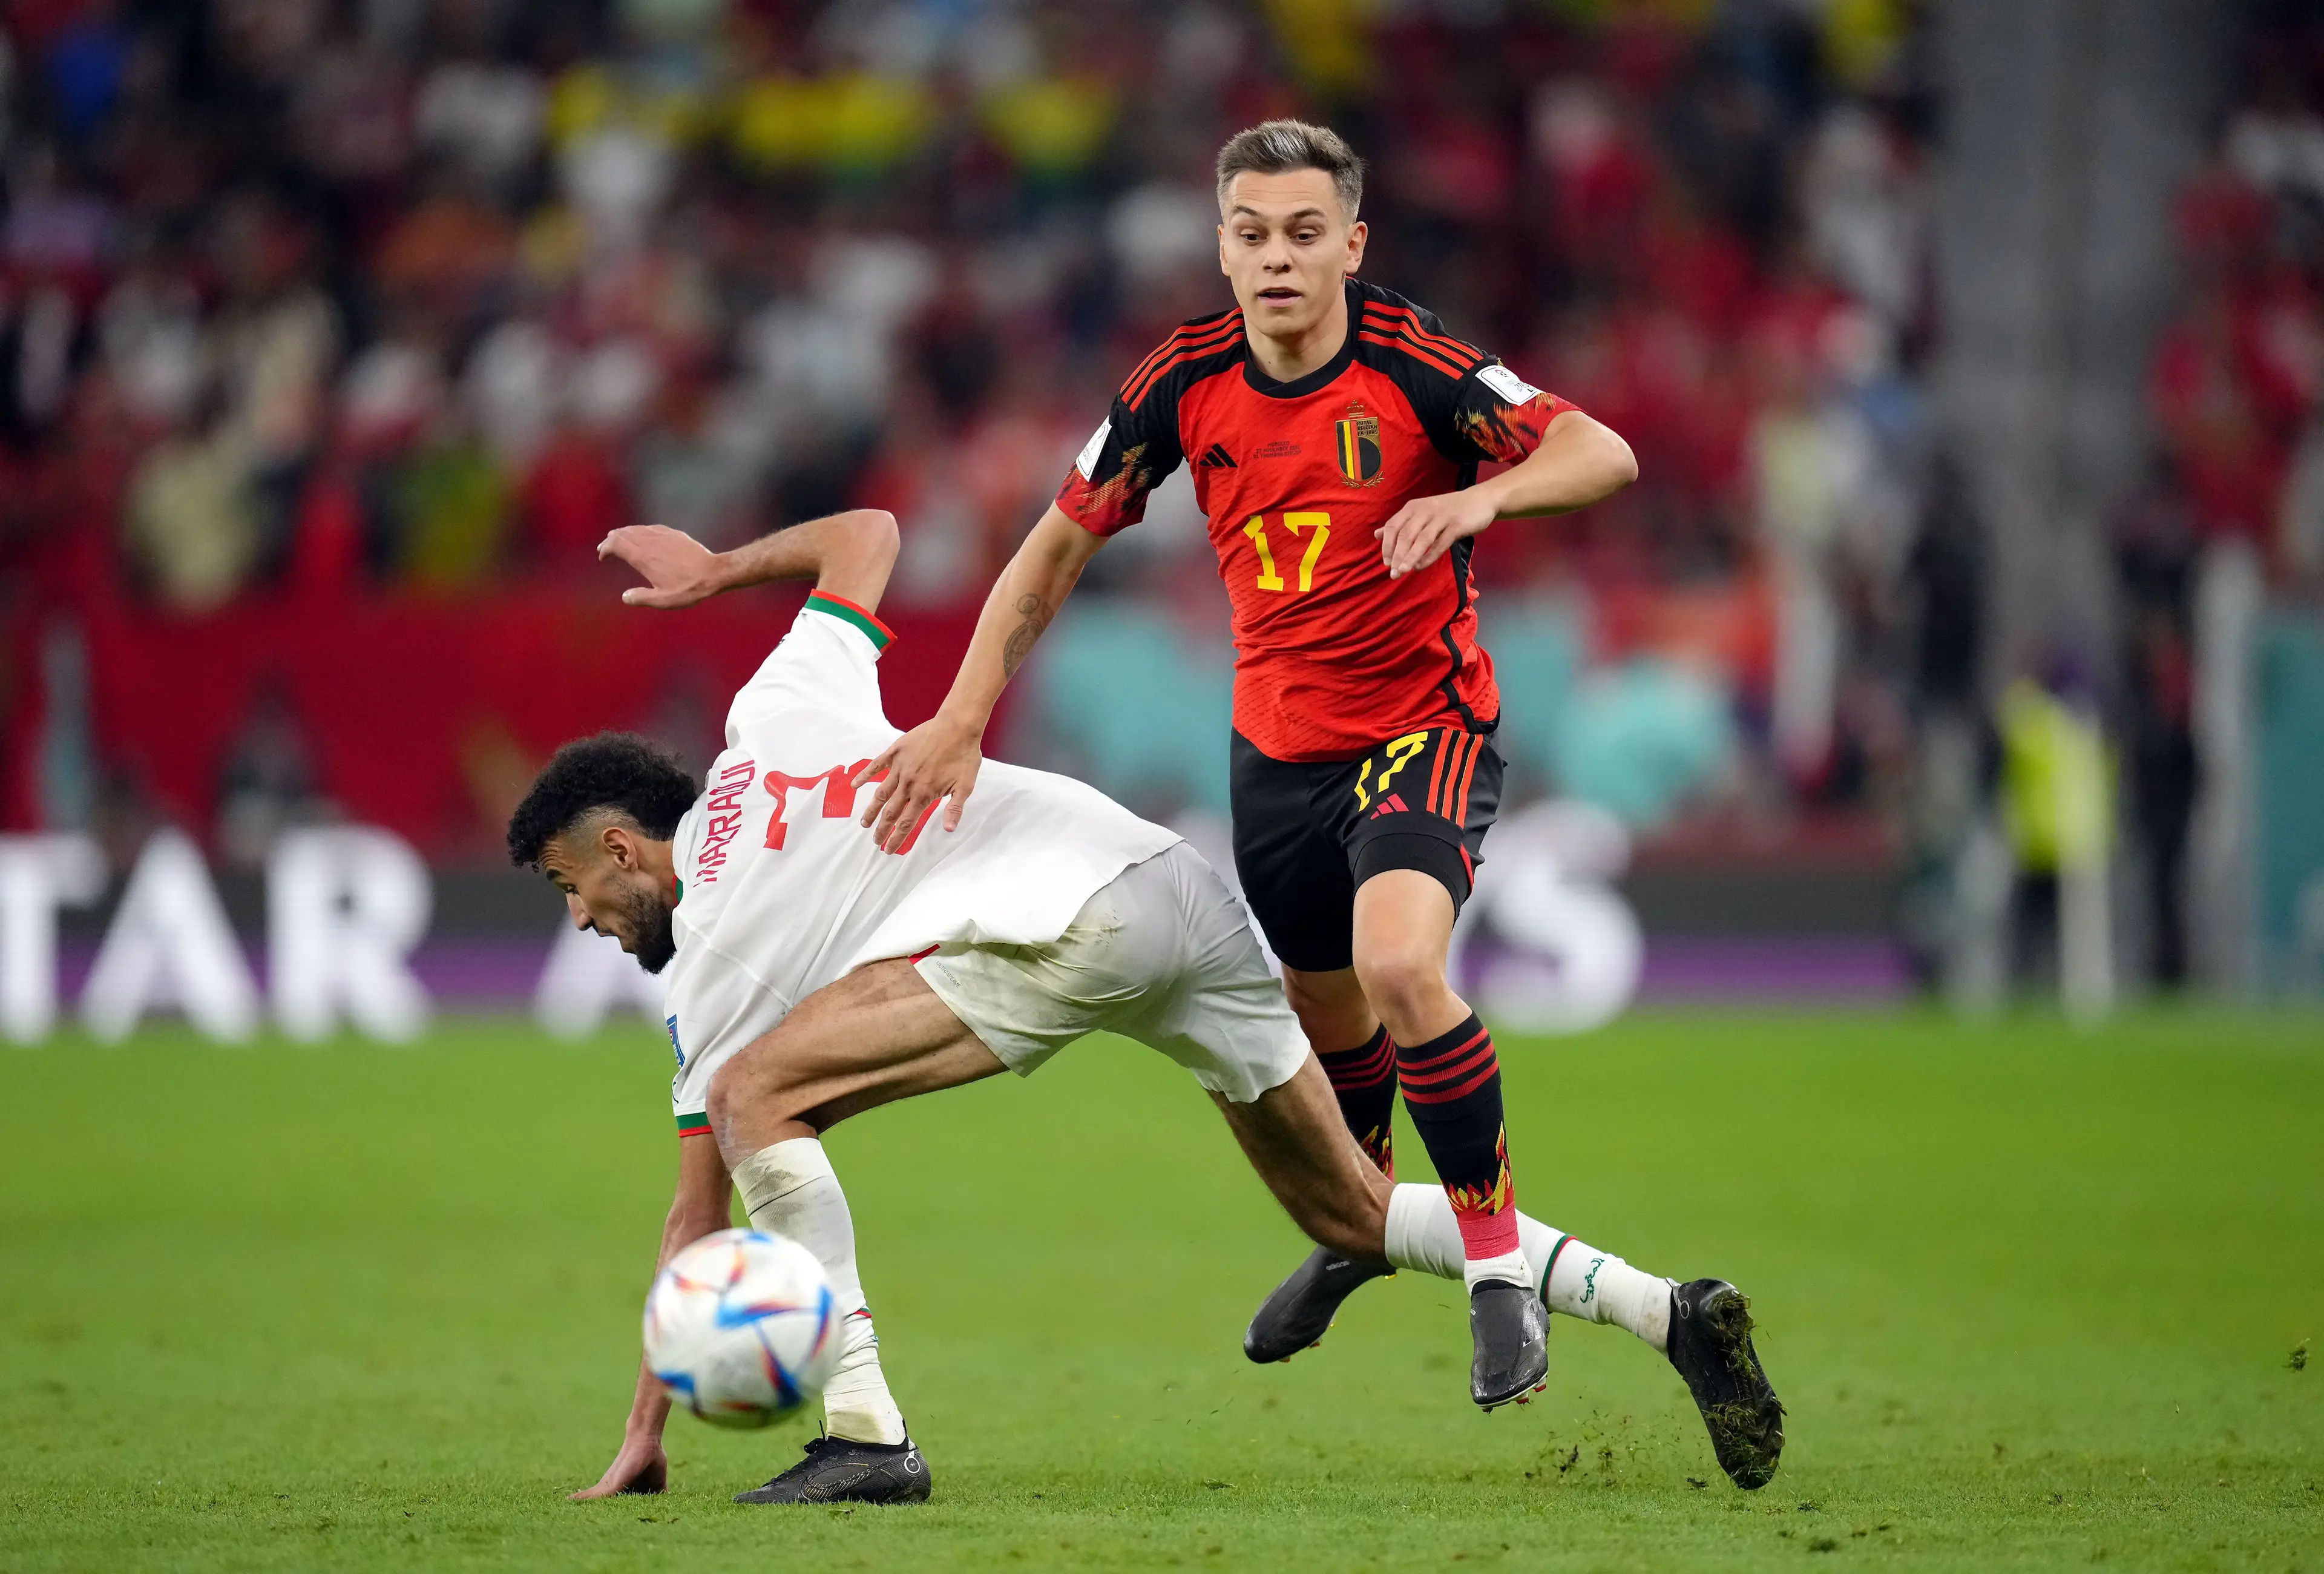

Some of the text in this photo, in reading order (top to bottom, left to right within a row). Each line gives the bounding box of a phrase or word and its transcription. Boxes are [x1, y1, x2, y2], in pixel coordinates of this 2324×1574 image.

[1242, 512, 1331, 592] 17
[1354, 731, 1428, 812] 17
[936, 960, 961, 989] ULTRAWEAVE
